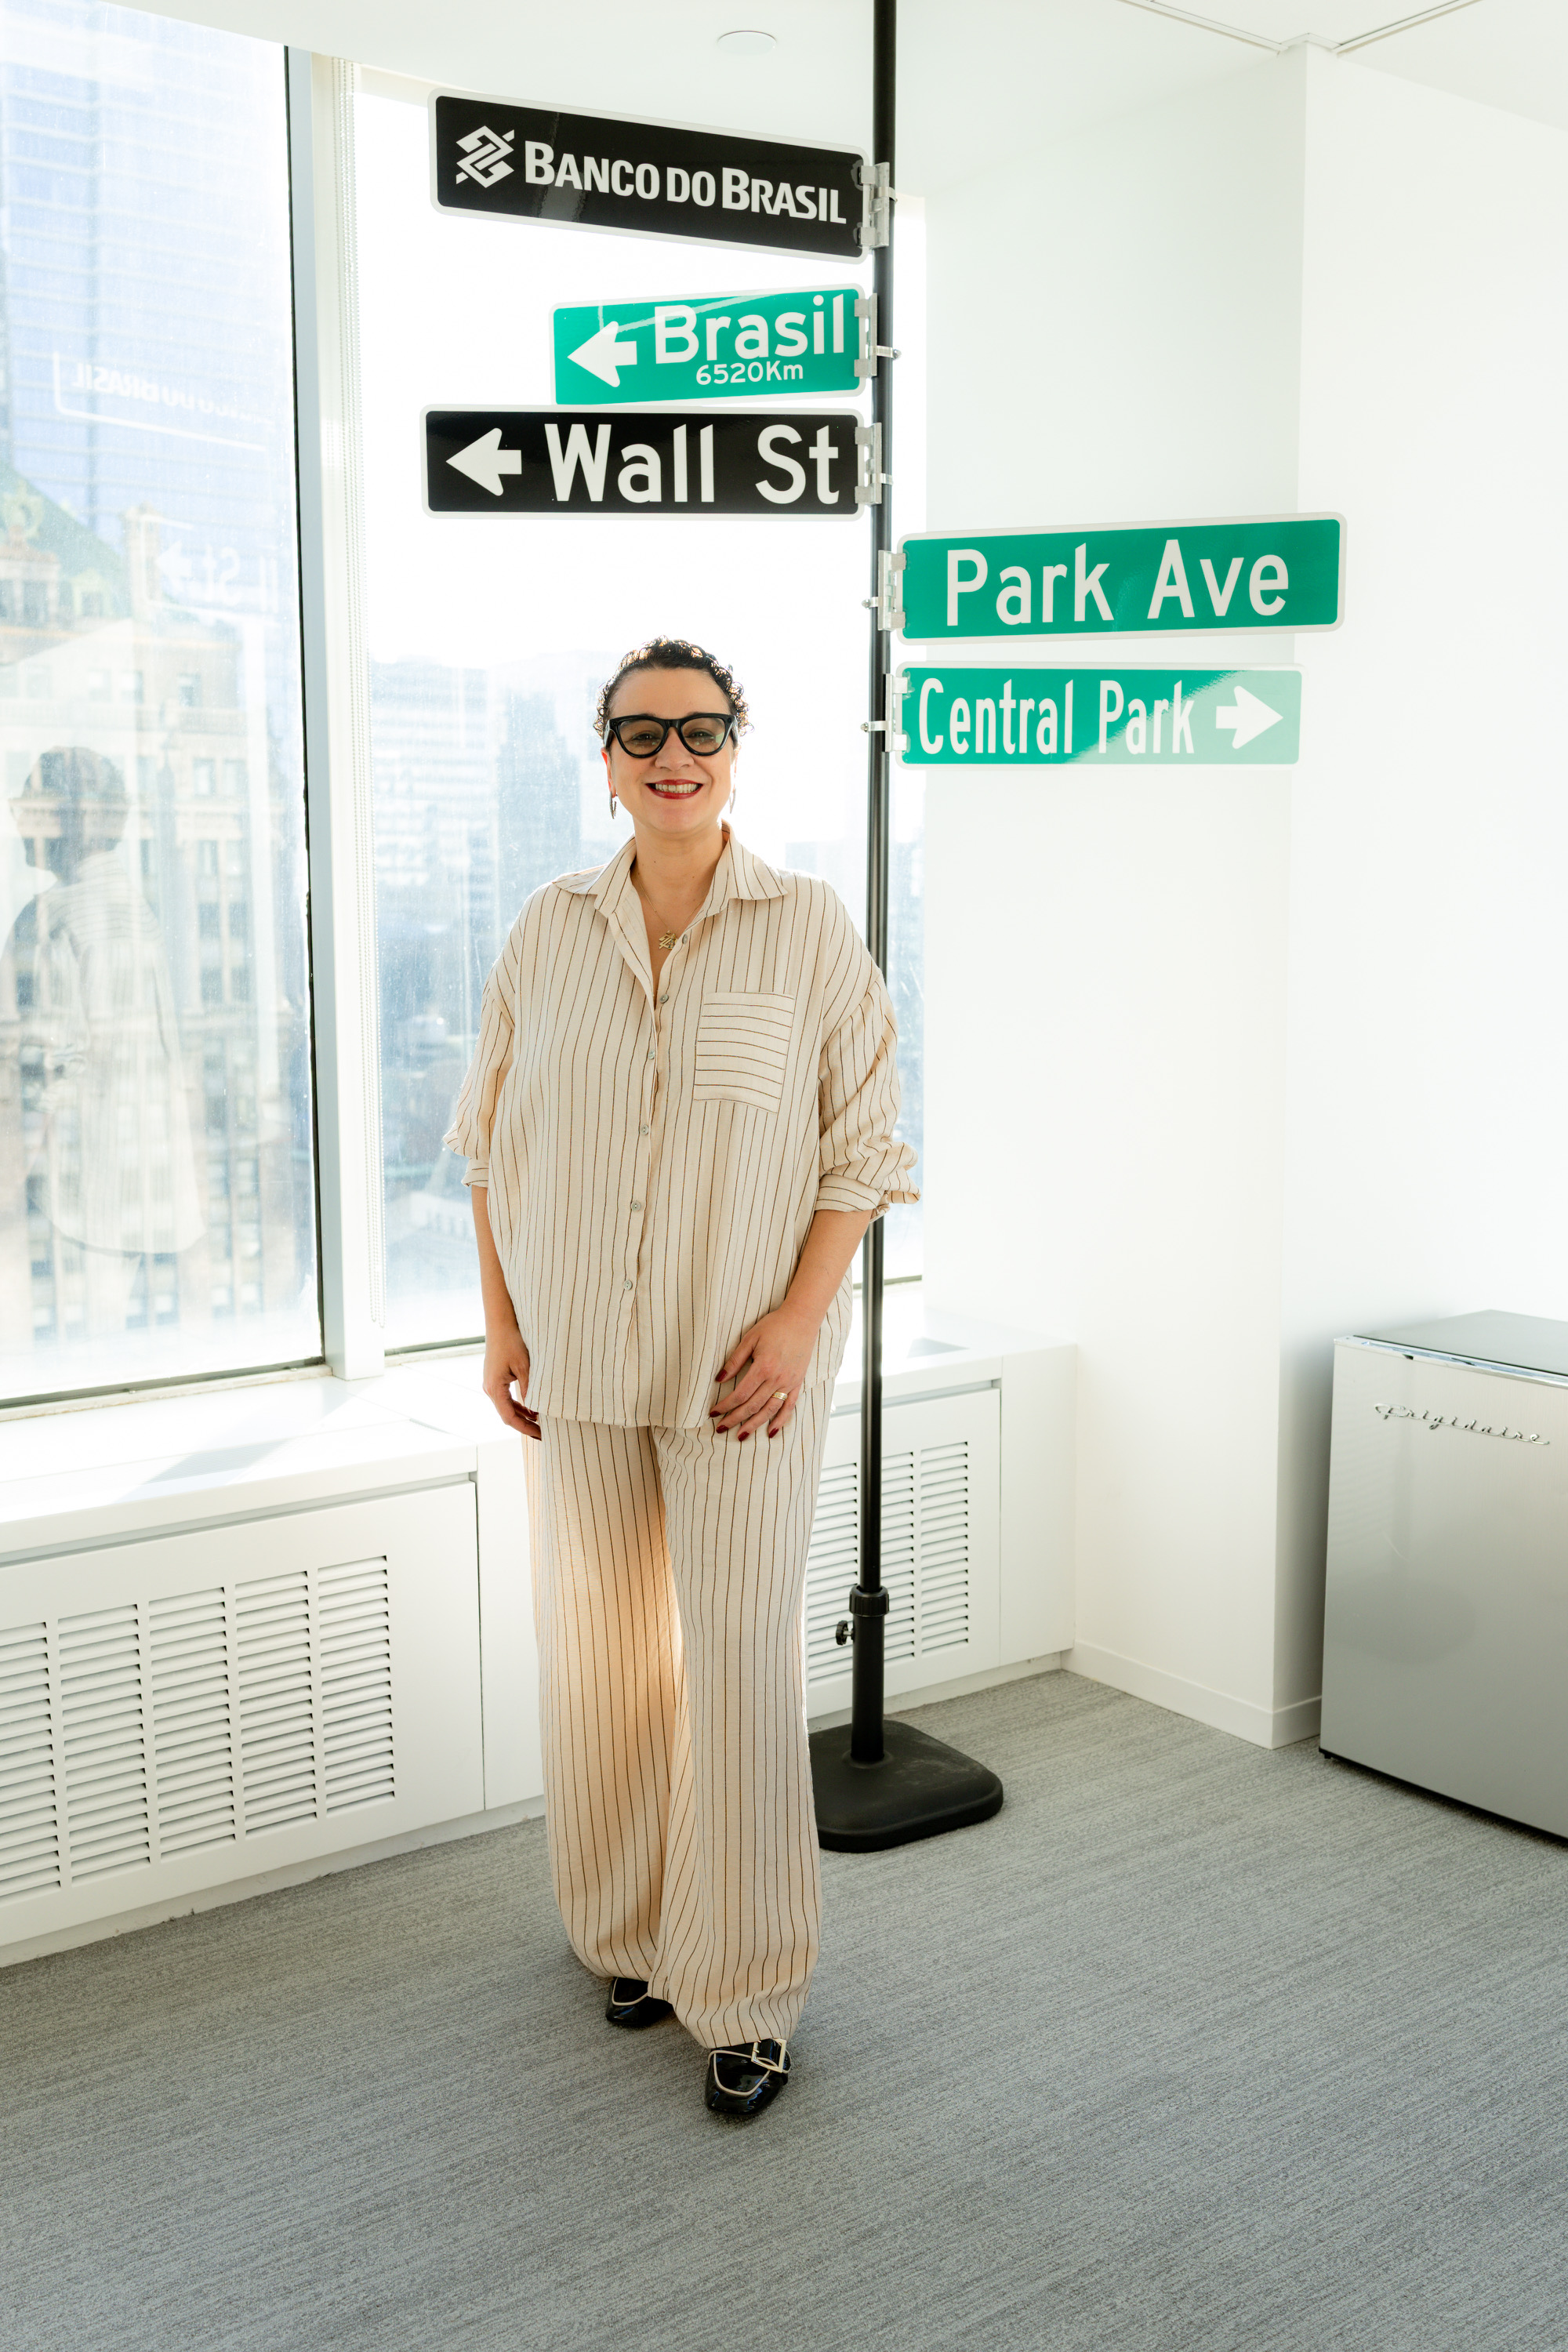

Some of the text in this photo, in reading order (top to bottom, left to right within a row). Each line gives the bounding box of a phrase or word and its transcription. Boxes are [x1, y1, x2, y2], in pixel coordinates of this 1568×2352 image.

[524, 140, 847, 224] BANCO DO BRASIL
[654, 292, 844, 364] Brasil
[695, 361, 804, 386] 6520Km
[544, 423, 840, 505] Wall St
[946, 539, 1290, 626] Park Ave
[918, 677, 1195, 755] Central Park
[1374, 1402, 1550, 1445] Frigidaire
